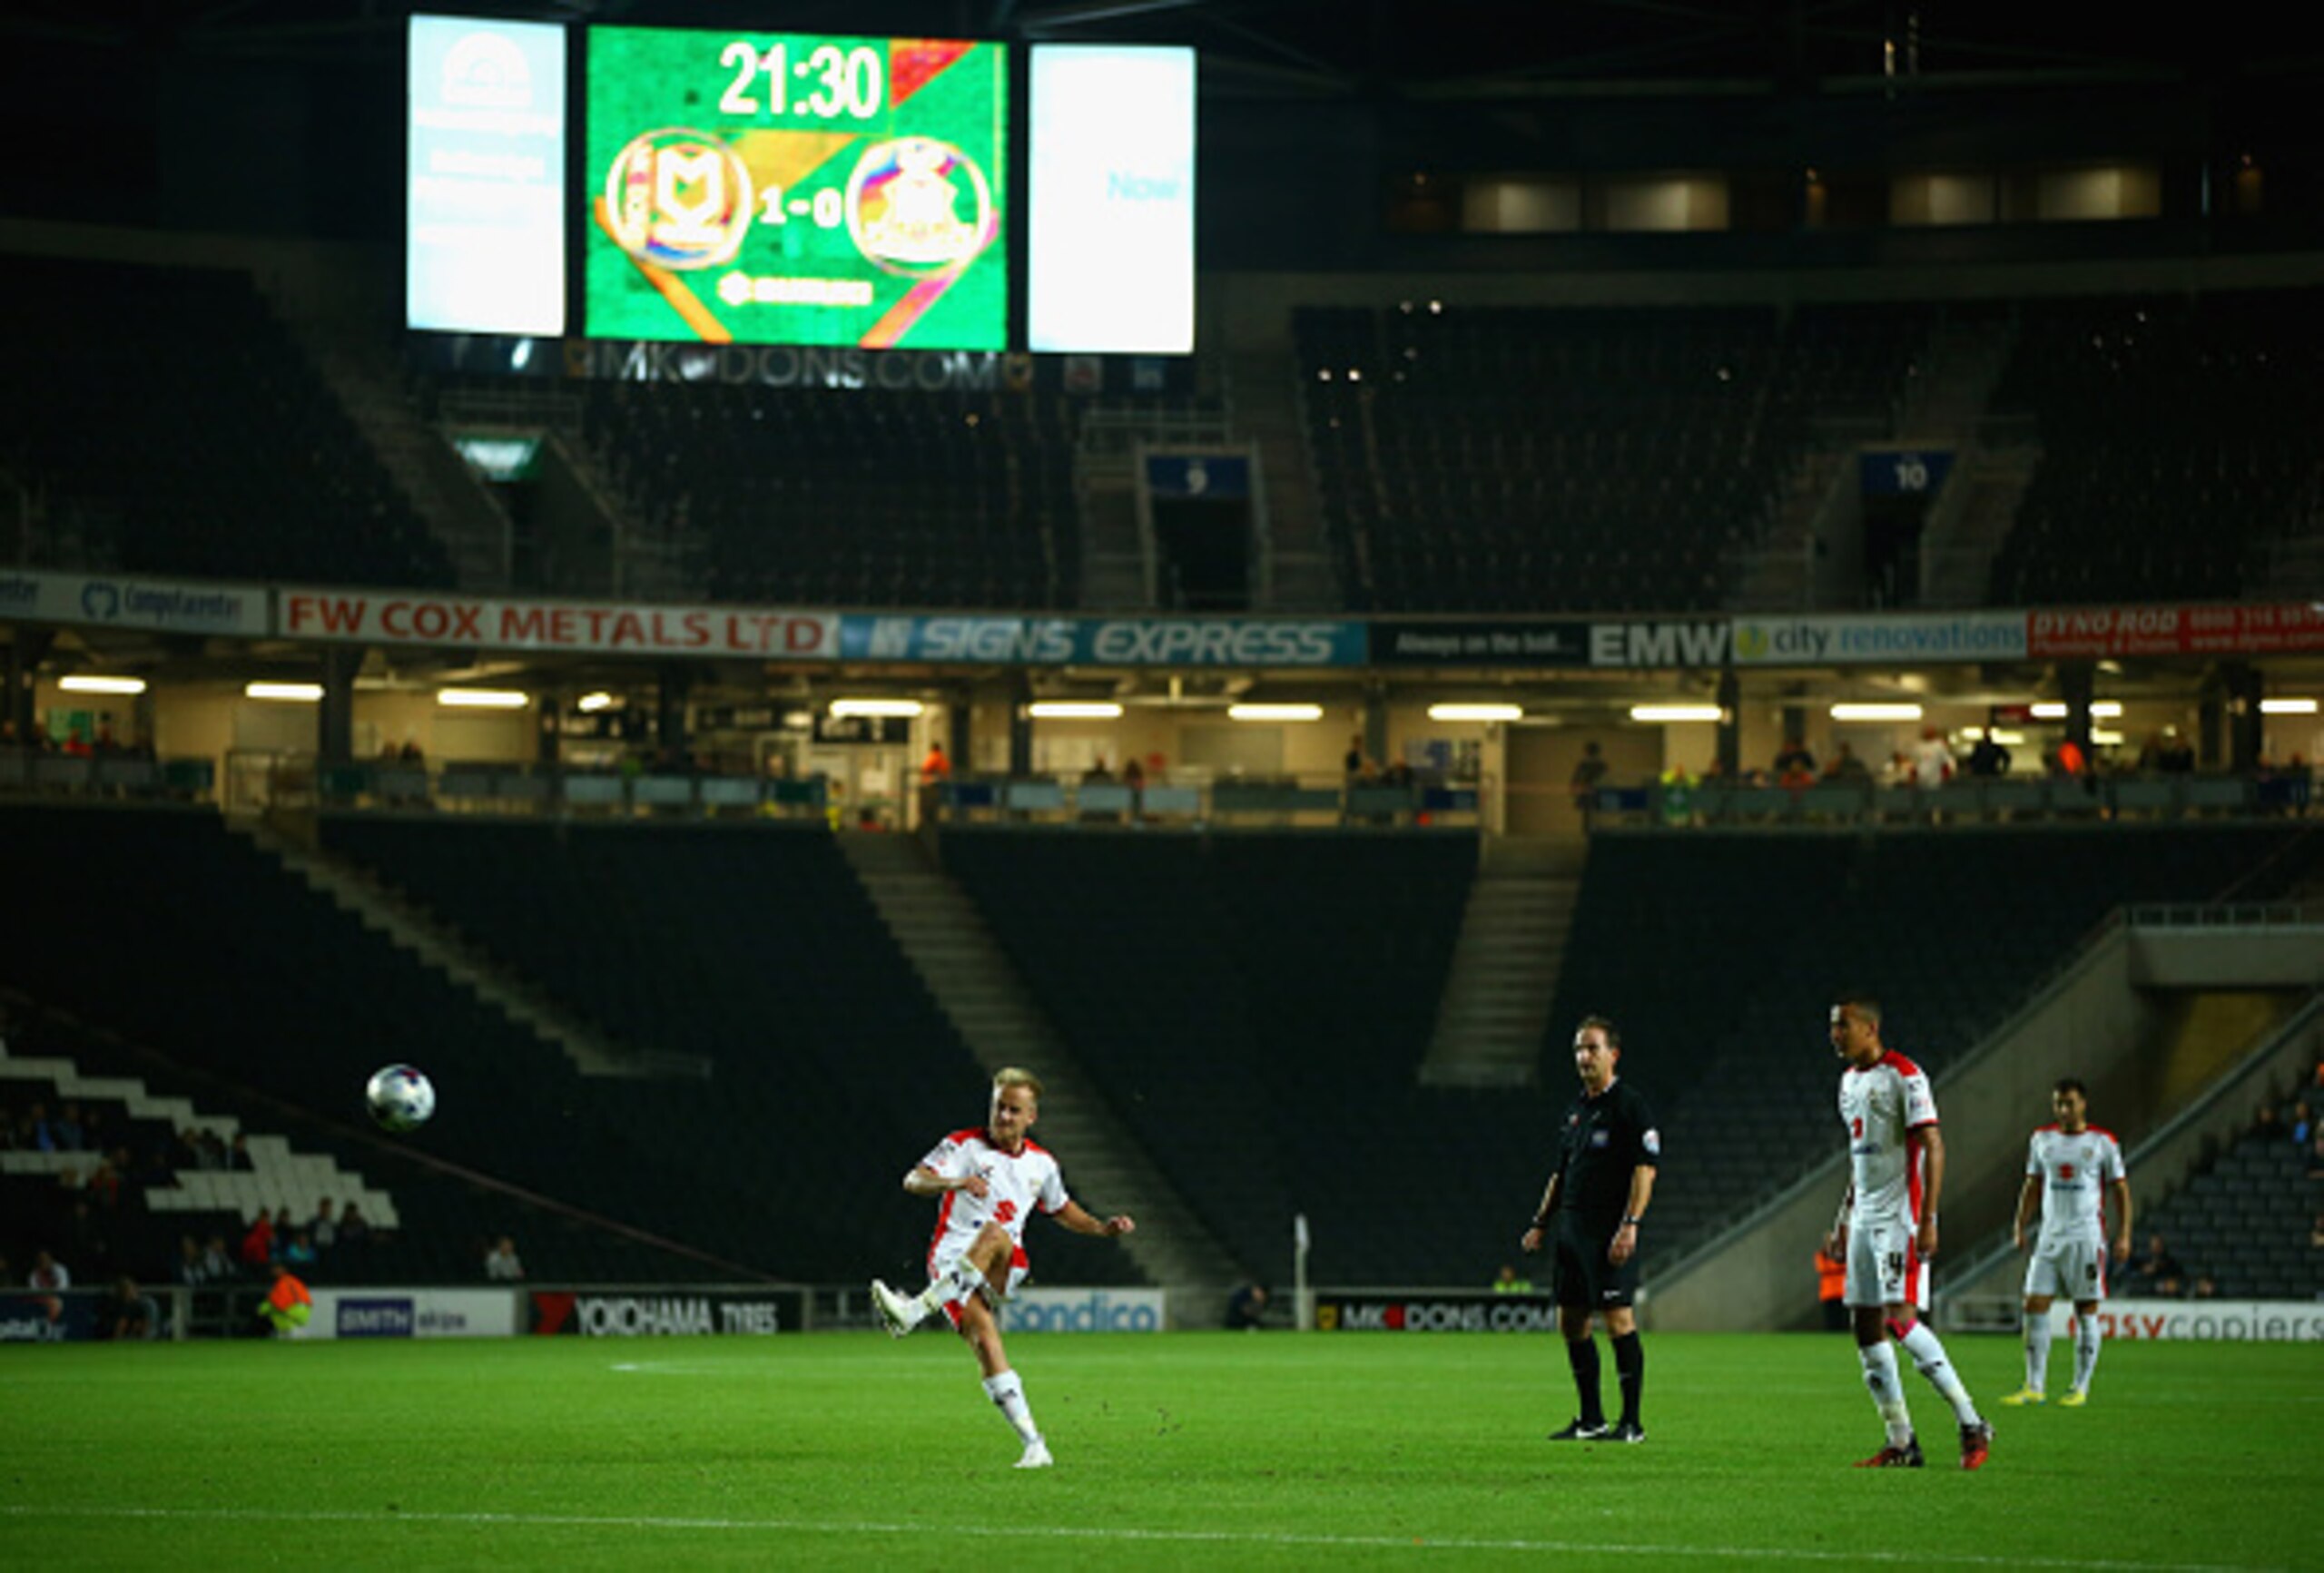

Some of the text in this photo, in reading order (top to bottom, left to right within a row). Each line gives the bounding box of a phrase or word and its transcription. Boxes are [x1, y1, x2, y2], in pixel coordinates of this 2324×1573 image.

[719, 42, 881, 118] 21:30
[760, 185, 842, 228] 1-0
[1186, 467, 1207, 495] 9
[1893, 462, 1929, 491] 10
[290, 595, 824, 652] FW COX METALS LTD
[918, 617, 1338, 663] SIGNS EXPRESS
[1774, 616, 2026, 659] city renovations
[1590, 624, 1728, 667] EMW
[340, 1307, 413, 1333] SMITH
[574, 1295, 779, 1334] YOKOHAMA TYRES
[1343, 1303, 1384, 1329] MK
